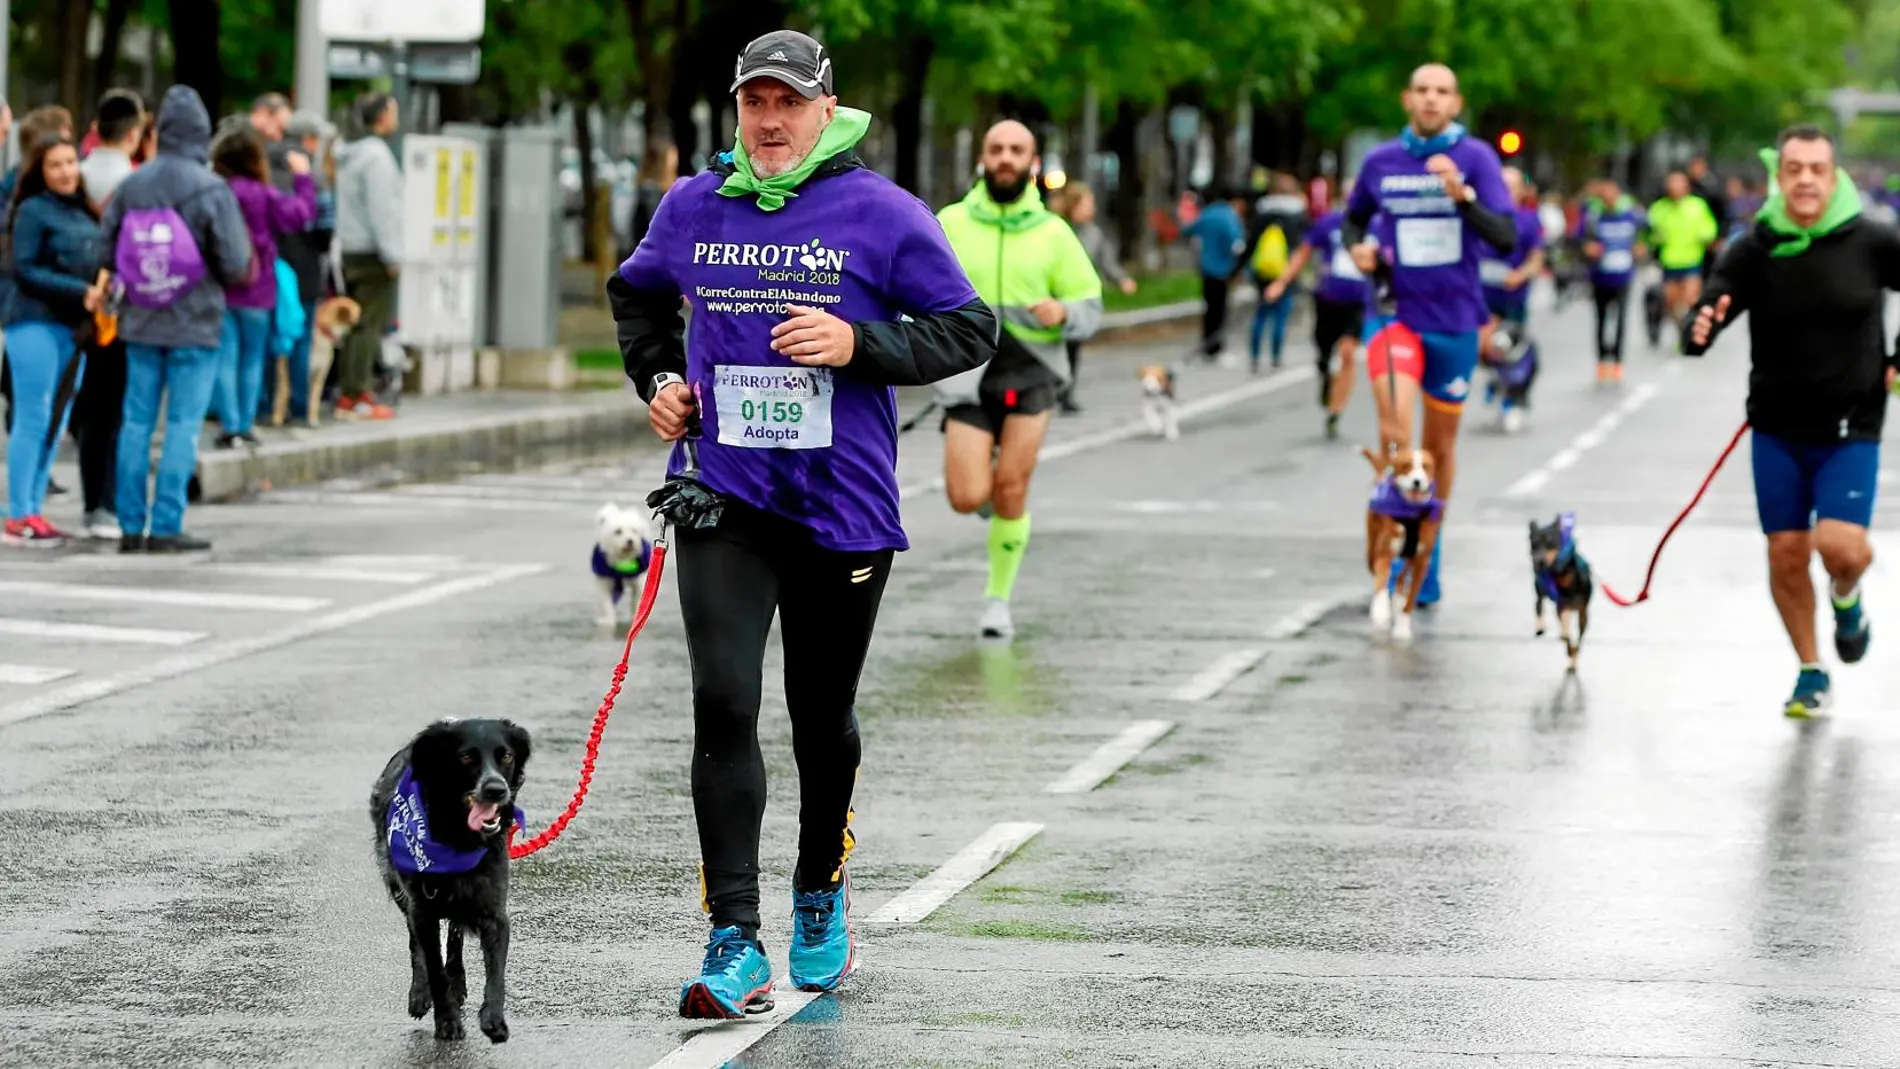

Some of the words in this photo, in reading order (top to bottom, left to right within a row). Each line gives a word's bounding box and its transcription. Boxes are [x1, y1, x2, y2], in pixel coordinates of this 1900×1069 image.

[758, 269, 805, 283] Madrid
[809, 271, 840, 285] 2018
[696, 286, 841, 303] #CorreContraElAbandono
[741, 399, 803, 423] 0159
[744, 425, 799, 442] Adopta
